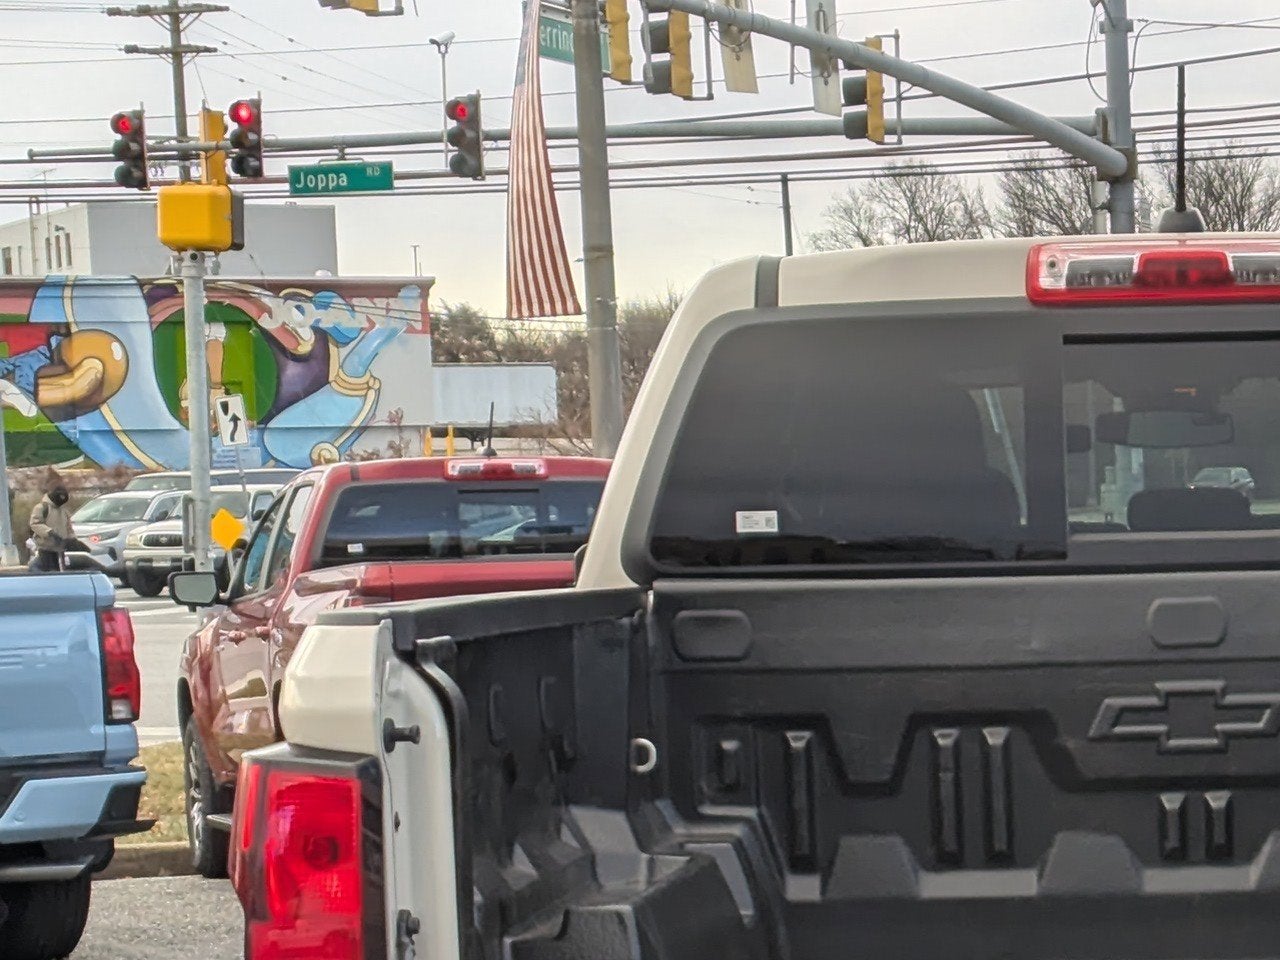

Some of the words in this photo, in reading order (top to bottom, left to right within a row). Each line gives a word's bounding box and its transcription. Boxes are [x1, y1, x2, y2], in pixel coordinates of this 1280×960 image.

[540, 24, 575, 54] errin
[295, 171, 348, 190] Joppa
[366, 166, 380, 176] RD
